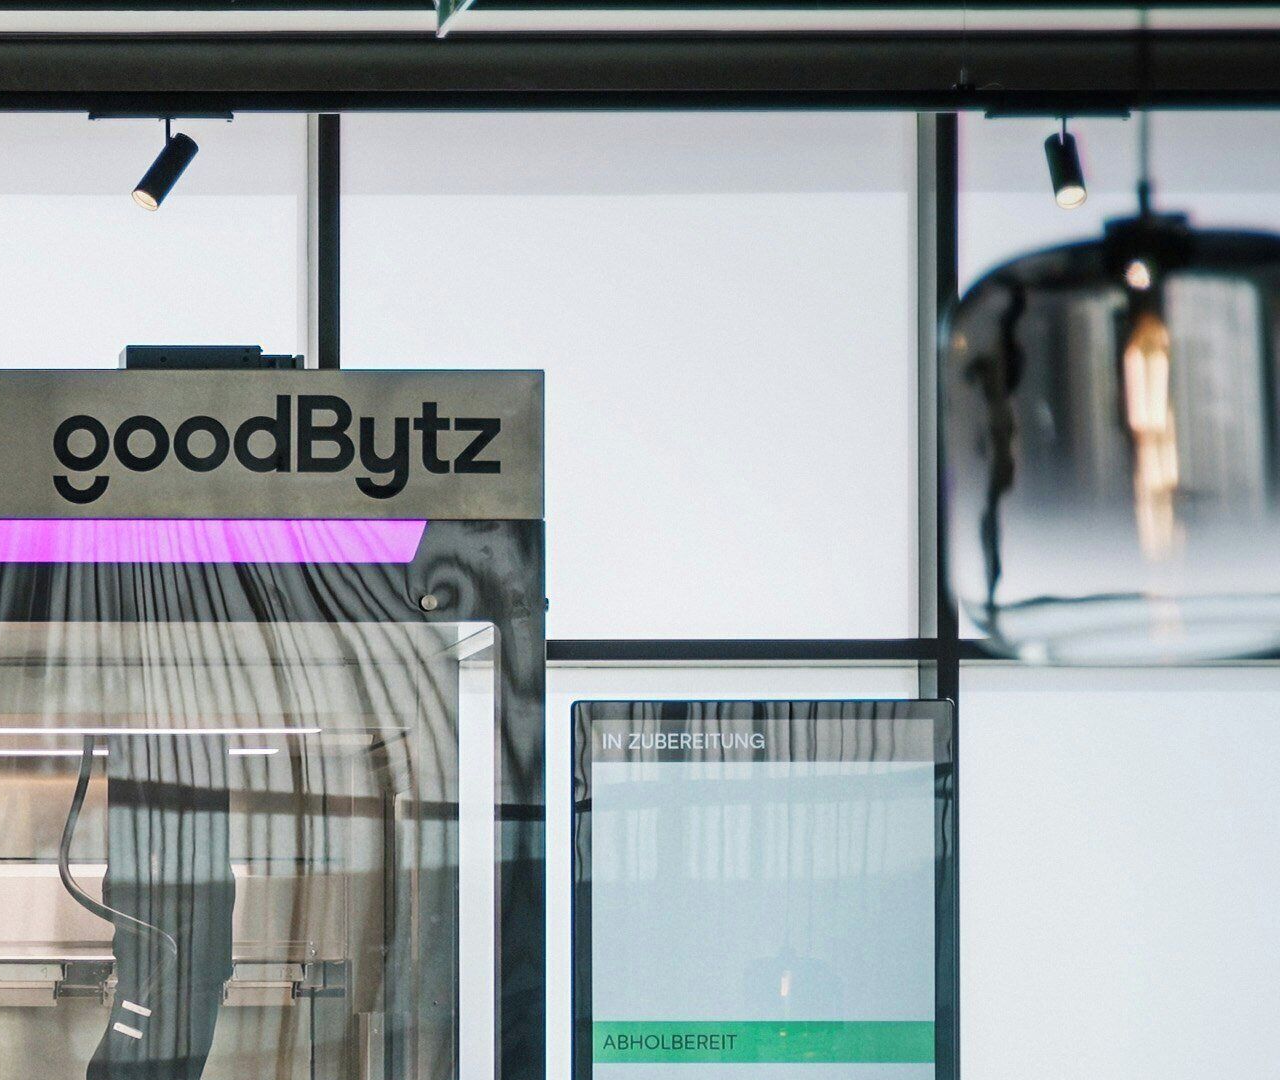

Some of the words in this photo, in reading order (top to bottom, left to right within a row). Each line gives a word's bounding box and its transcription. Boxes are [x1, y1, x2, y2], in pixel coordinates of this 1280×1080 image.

[52, 394, 502, 505] goodBytz
[601, 733, 622, 750] IN
[628, 733, 766, 750] ZUBEREITUNG
[603, 1034, 737, 1050] ABHOLBEREIT
